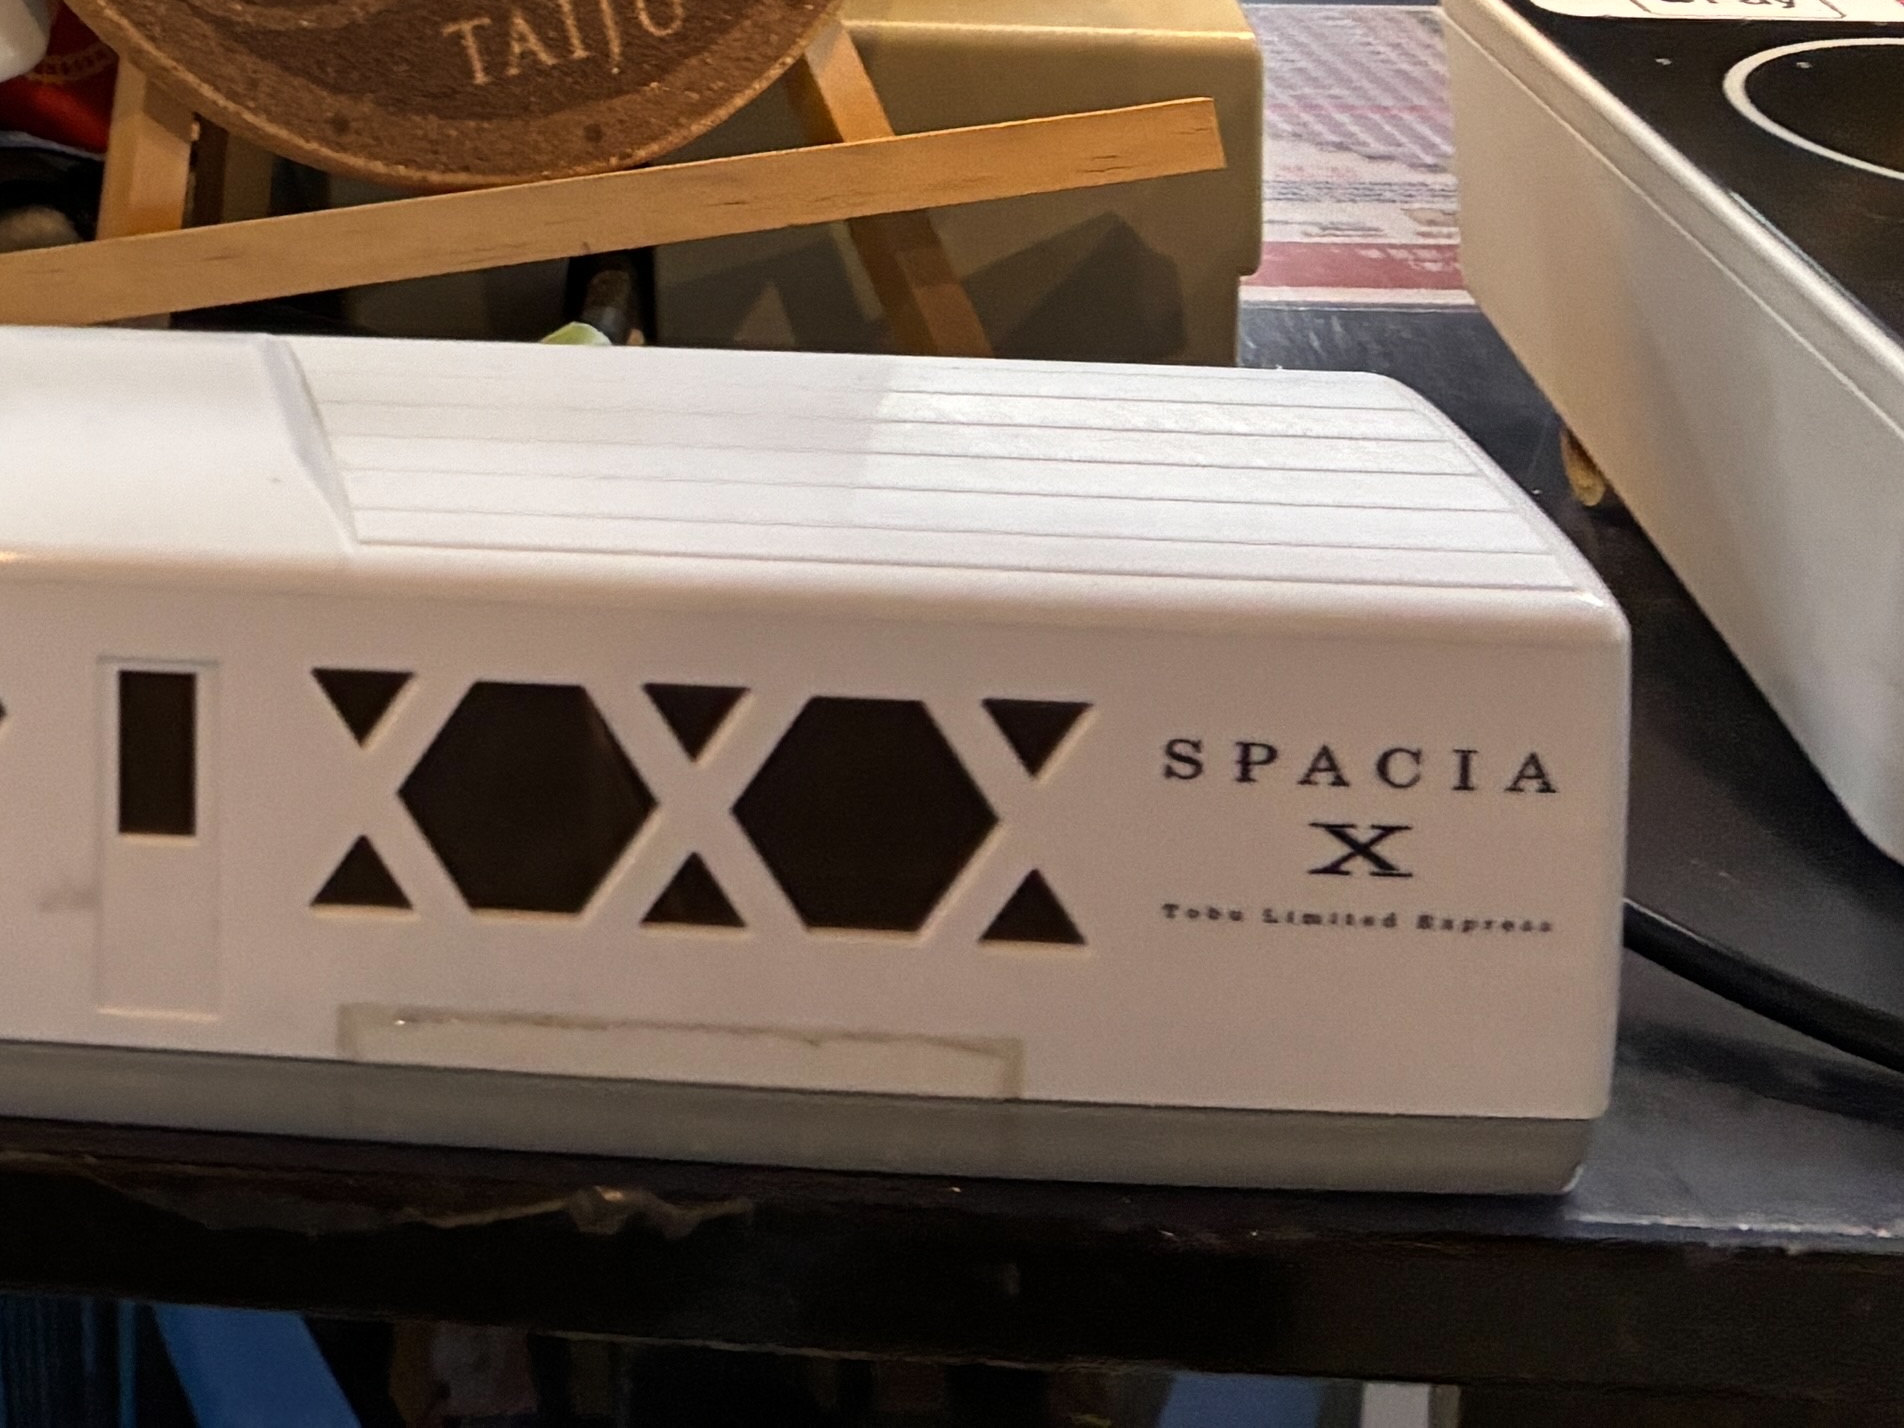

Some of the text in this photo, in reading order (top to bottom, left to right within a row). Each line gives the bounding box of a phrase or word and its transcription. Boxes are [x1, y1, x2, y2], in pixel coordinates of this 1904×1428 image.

[1161, 737, 1559, 794] SPACIA
[1307, 821, 1414, 879] X
[1160, 903, 1245, 923] Tobu
[1261, 906, 1398, 930] Limited
